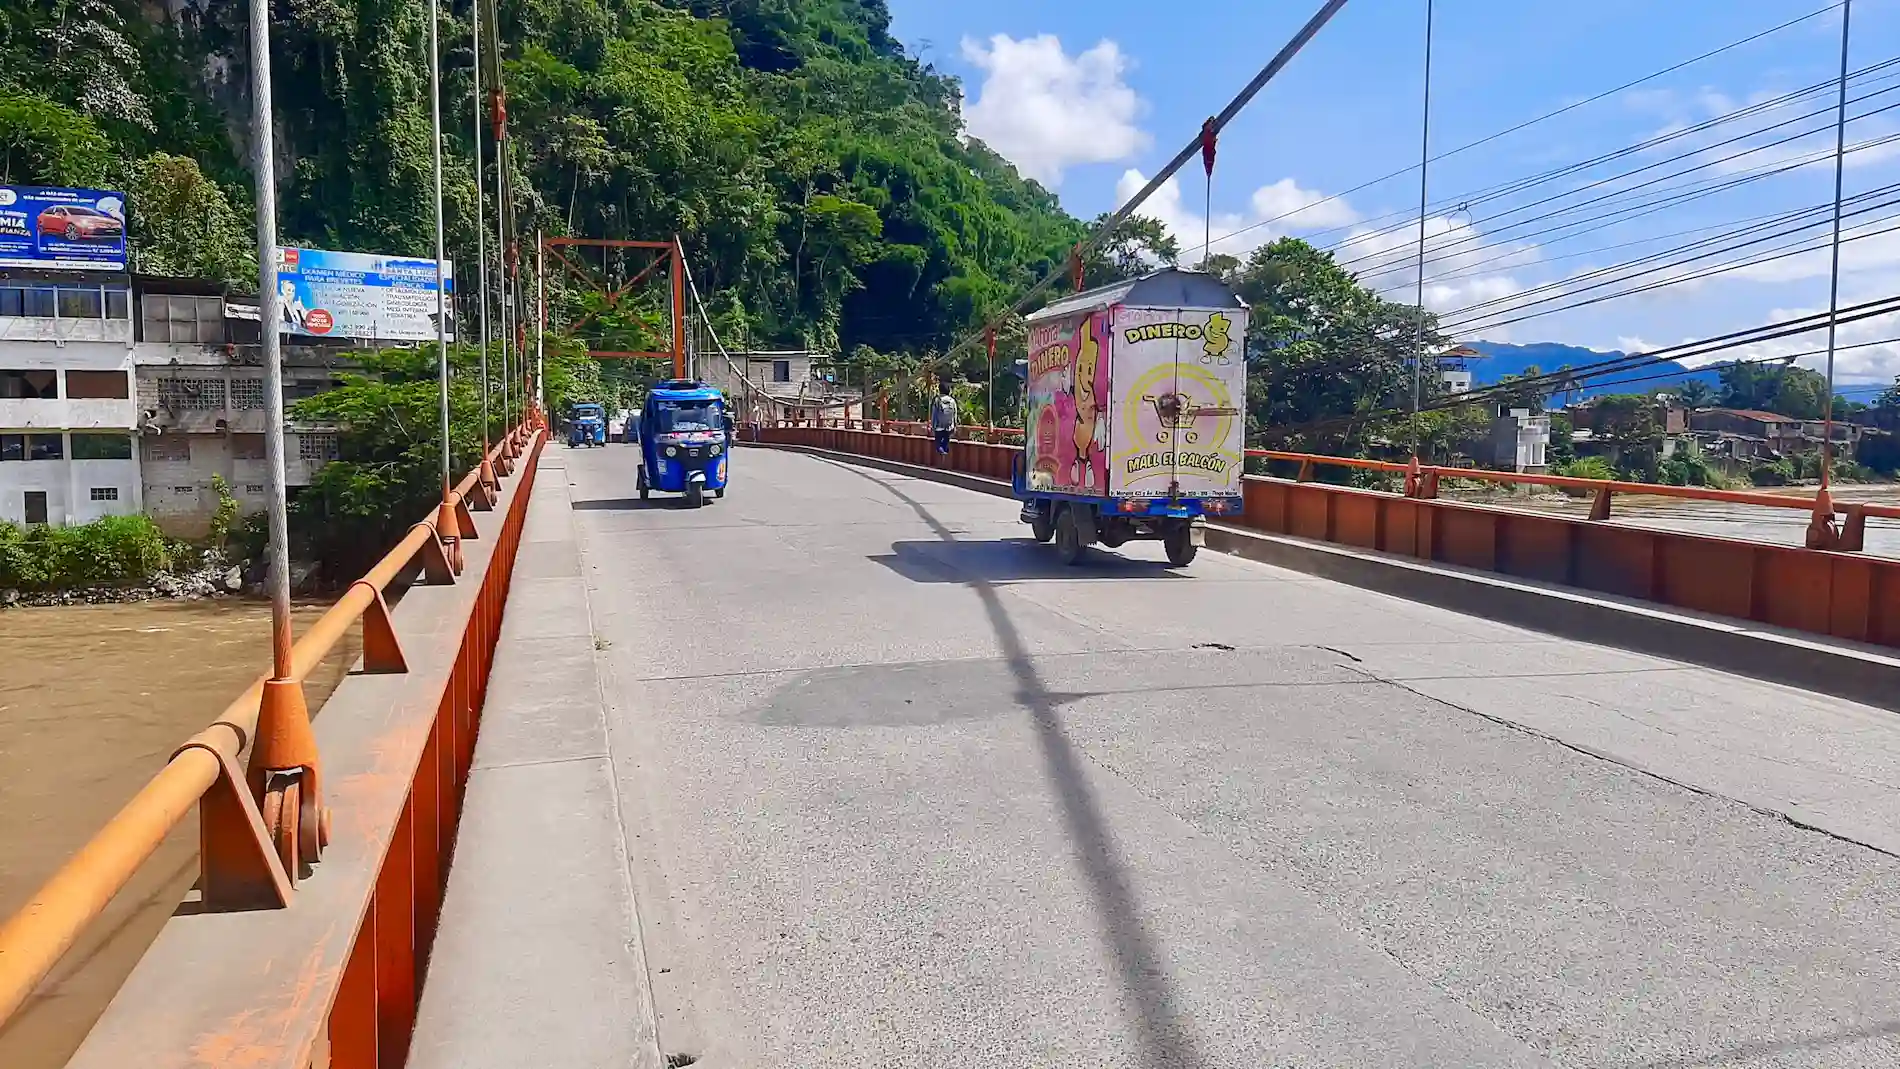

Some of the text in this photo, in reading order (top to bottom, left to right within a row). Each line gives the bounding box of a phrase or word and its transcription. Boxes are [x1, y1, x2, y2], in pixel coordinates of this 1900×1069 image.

[301, 267, 334, 278] EXAMEN
[304, 275, 325, 283] PARA
[1125, 323, 1202, 344] DINERO
[1031, 344, 1069, 381] DINERO
[1127, 451, 1226, 473] MALL EL BALCÓN
